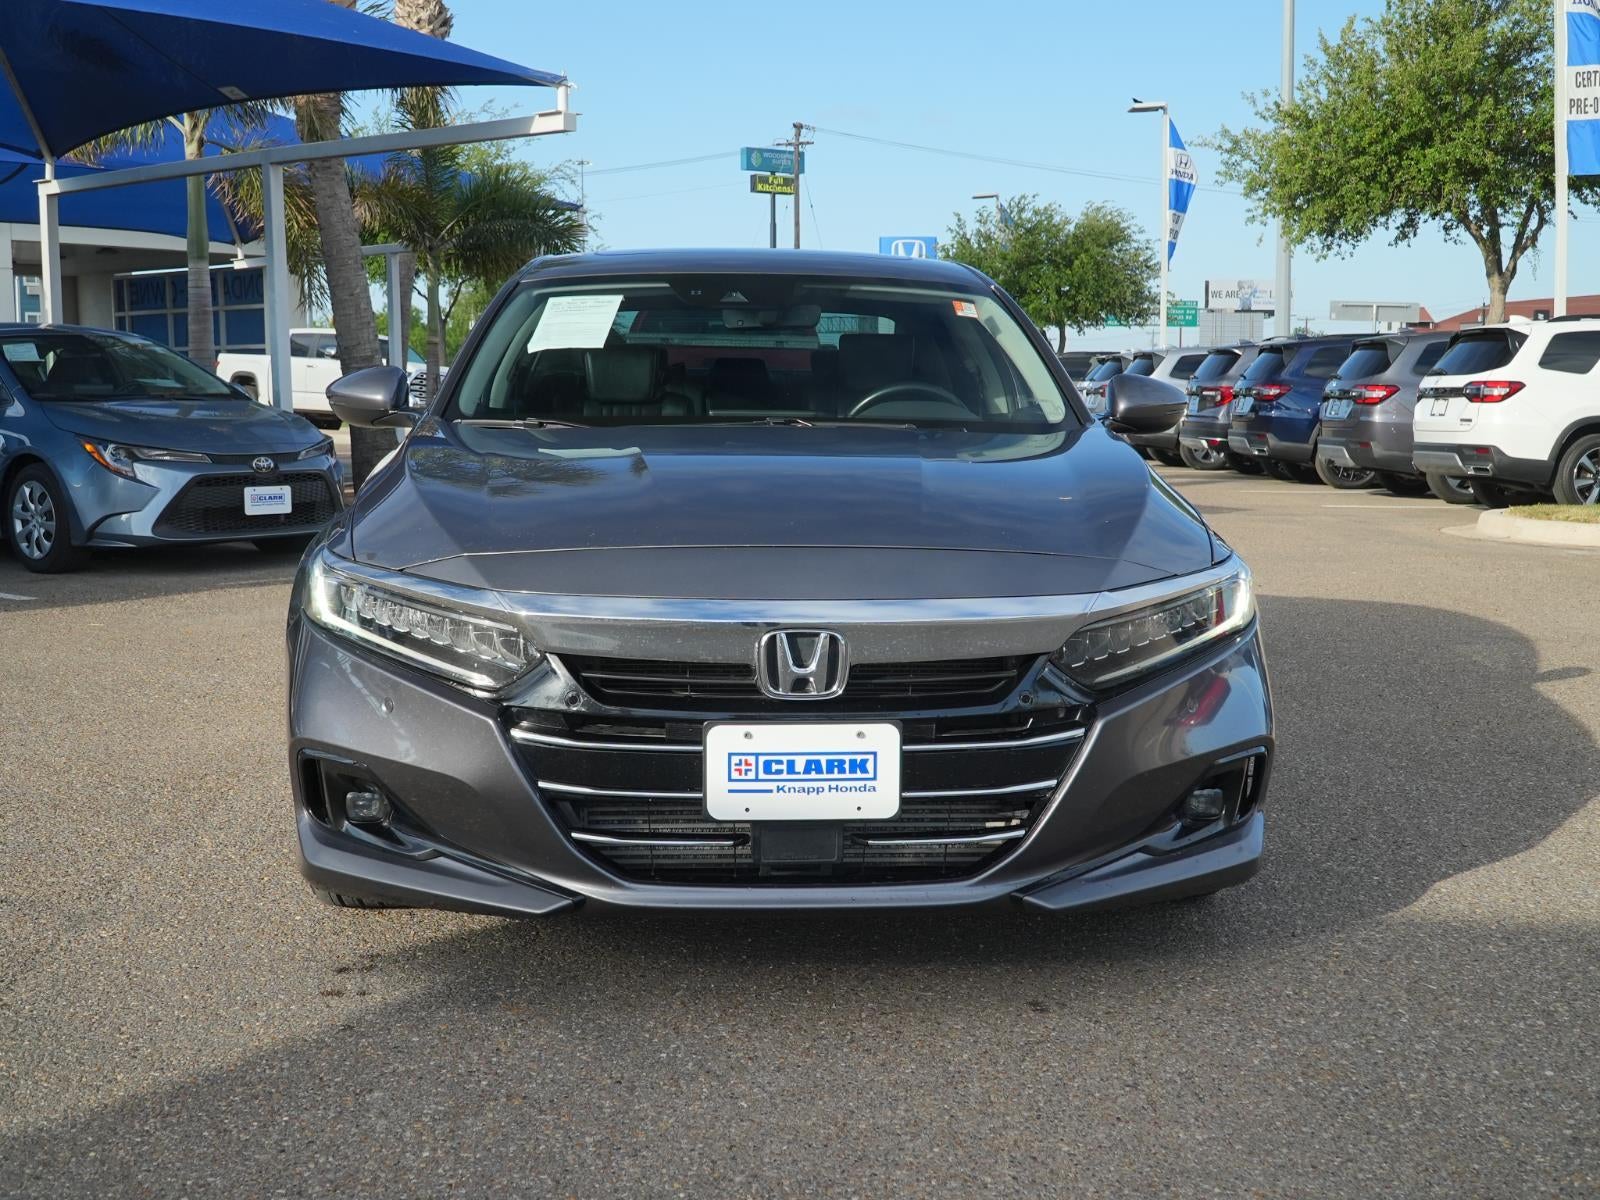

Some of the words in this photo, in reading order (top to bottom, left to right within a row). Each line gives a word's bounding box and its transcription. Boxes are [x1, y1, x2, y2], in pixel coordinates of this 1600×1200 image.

[1568, 96, 1600, 116] PRE-O
[768, 176, 784, 184] Full
[1210, 290, 1224, 299] WE
[1225, 290, 1241, 299] ARE
[762, 758, 870, 776] CLARK
[776, 784, 825, 796] Knapp
[828, 783, 877, 793] Honda
